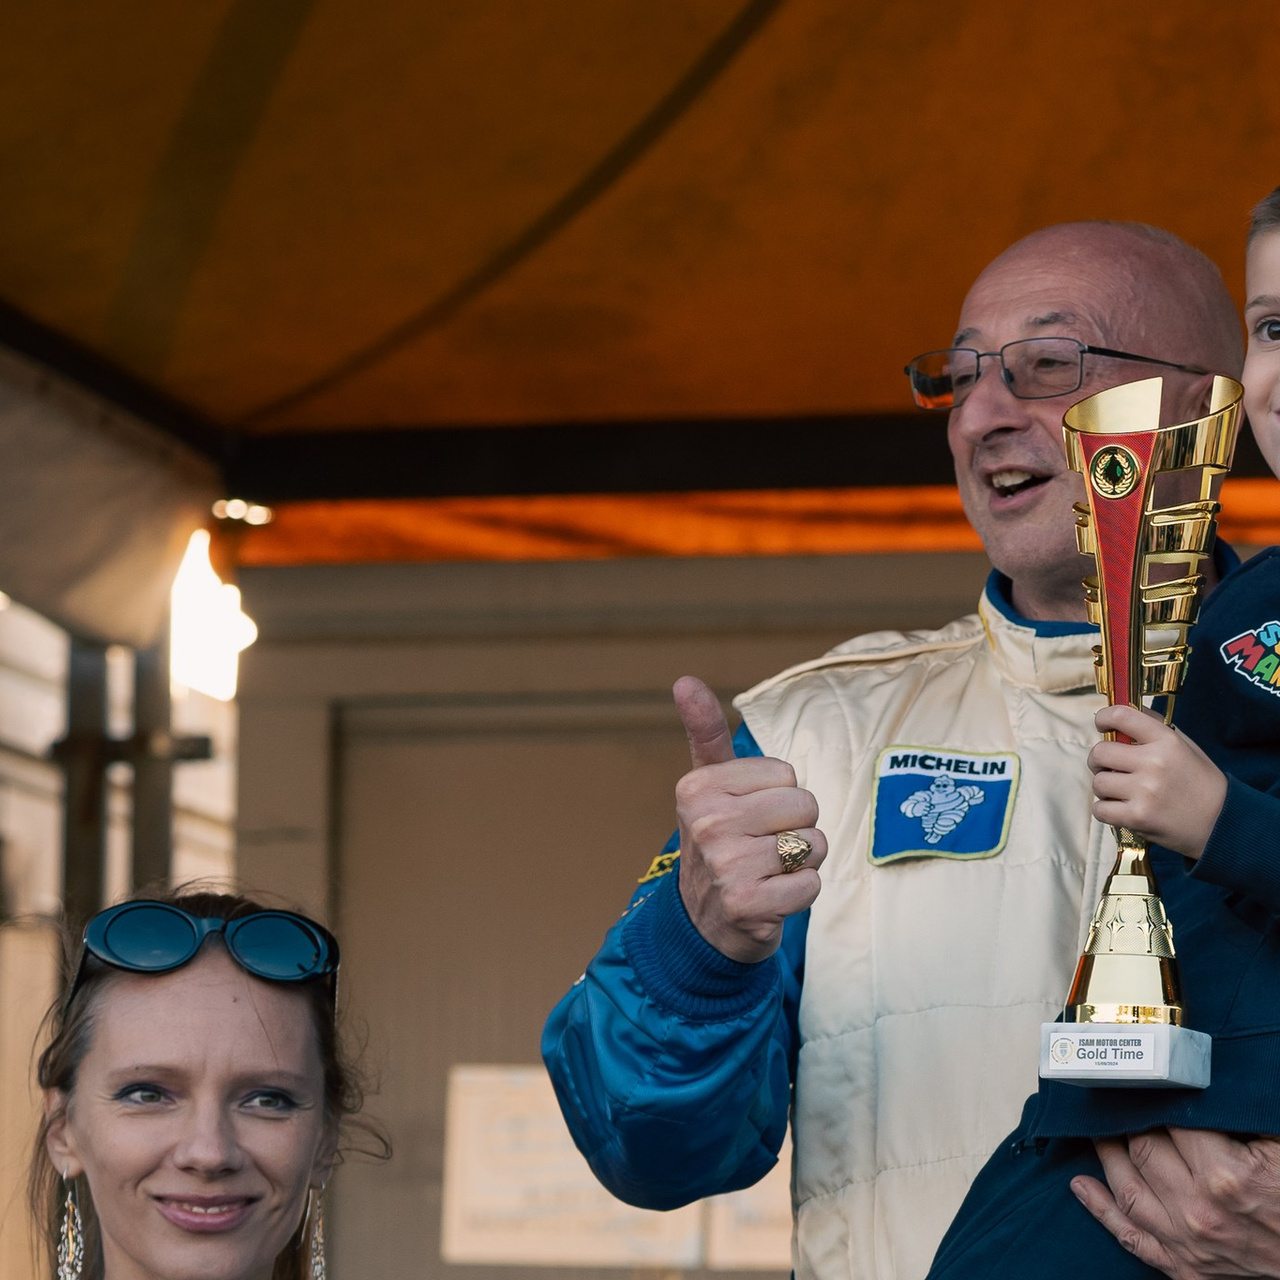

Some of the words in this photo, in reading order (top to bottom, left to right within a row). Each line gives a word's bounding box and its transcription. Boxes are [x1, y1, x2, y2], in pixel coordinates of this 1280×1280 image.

[888, 754, 1007, 776] MICHELIN
[1078, 1038, 1095, 1047] ISAM
[1096, 1038, 1118, 1047] MOTOR
[1118, 1038, 1142, 1047] CENTER
[1076, 1047, 1108, 1060] Gold
[1111, 1047, 1144, 1060] Time
